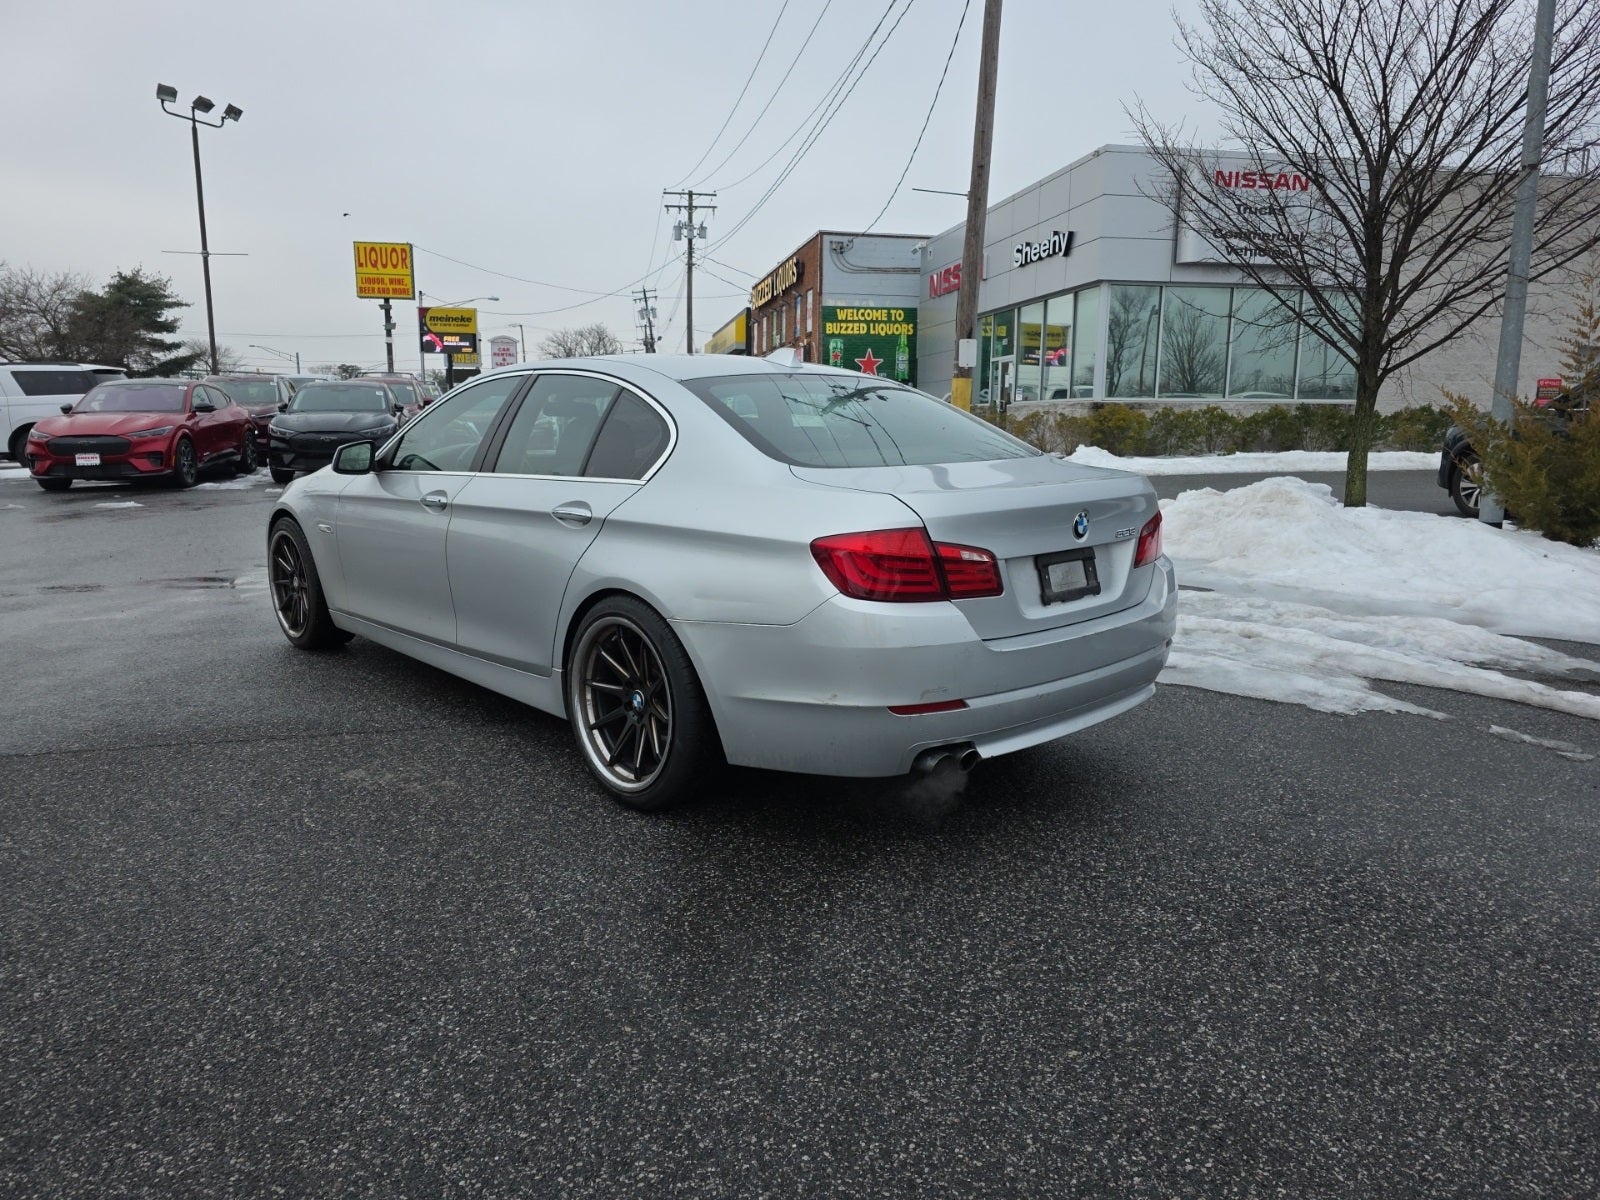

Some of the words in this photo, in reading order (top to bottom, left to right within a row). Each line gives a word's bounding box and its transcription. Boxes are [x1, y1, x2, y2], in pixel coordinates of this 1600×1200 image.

[1215, 170, 1310, 191] NISSAN
[1013, 230, 1069, 267] Sheehy
[356, 246, 409, 271] LIQUOR
[360, 277, 388, 286] LIQUOR,
[773, 256, 797, 296] LIQUORS
[377, 287, 391, 295] AND
[392, 287, 410, 296] MORE
[429, 315, 473, 323] meineke
[836, 308, 888, 321] WELCOME
[890, 309, 905, 321] TO
[826, 322, 867, 335] BUZZED
[869, 323, 914, 336] LIQUORS
